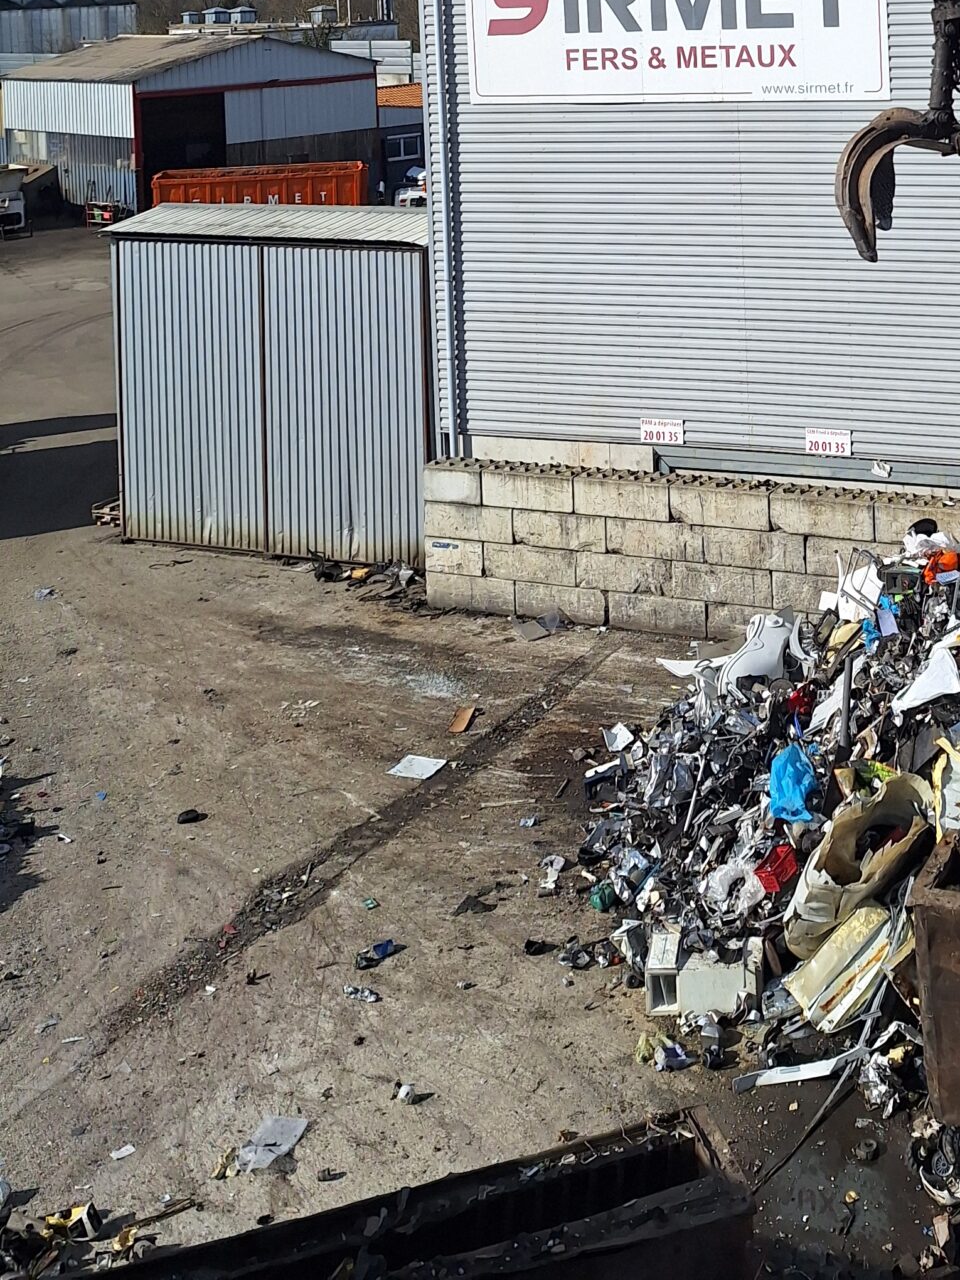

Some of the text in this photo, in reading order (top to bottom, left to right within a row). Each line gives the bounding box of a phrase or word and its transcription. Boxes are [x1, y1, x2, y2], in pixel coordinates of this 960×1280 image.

[565, 44, 797, 70] FERS & METAUX
[761, 81, 854, 94] www.sirmet.fr
[643, 430, 654, 441] 20
[655, 430, 665, 441] 01
[808, 440, 819, 451] 20
[821, 441, 832, 452] 01
